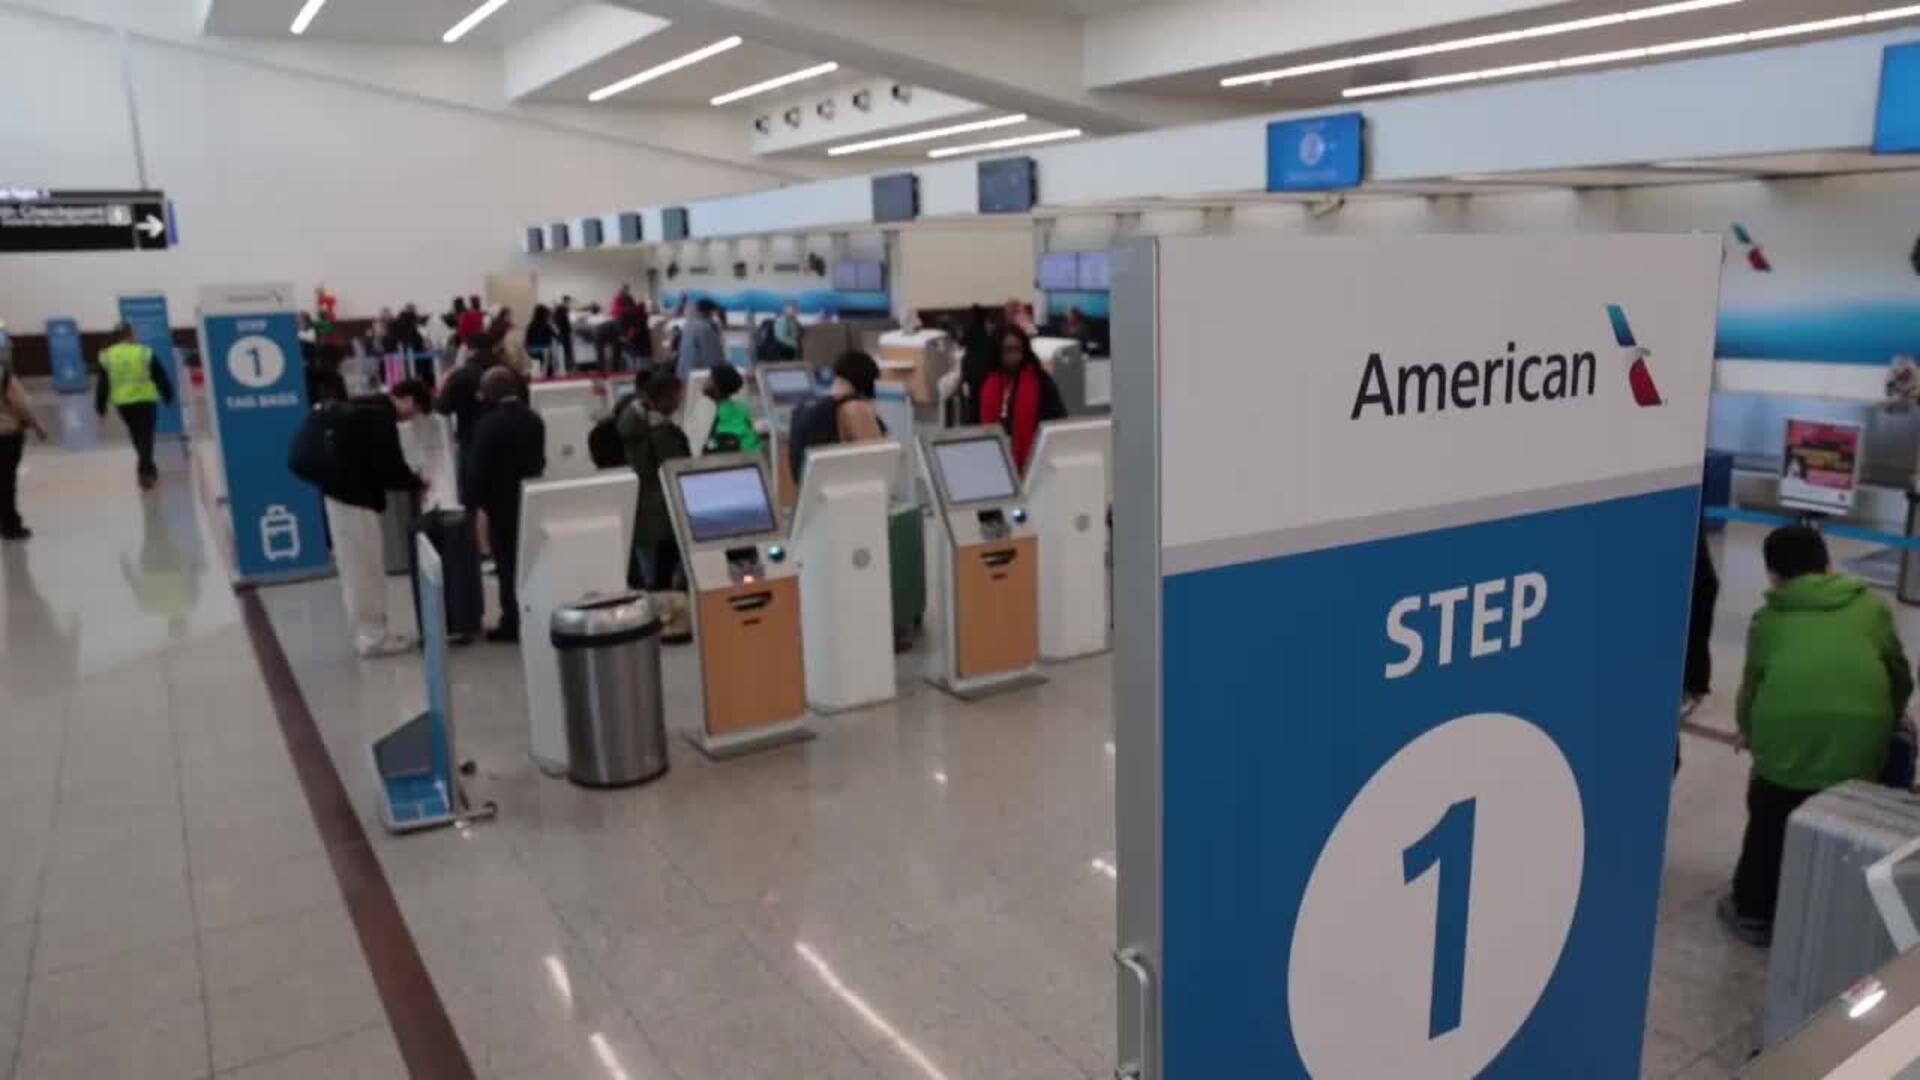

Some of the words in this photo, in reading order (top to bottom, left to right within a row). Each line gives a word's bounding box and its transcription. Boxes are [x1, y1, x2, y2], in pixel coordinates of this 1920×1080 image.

[226, 395, 257, 409] TAG
[259, 391, 298, 406] BAGS
[245, 345, 262, 378] 1
[1351, 341, 1597, 420] American
[1385, 571, 1548, 679] STEP
[1402, 796, 1476, 1041] 1
